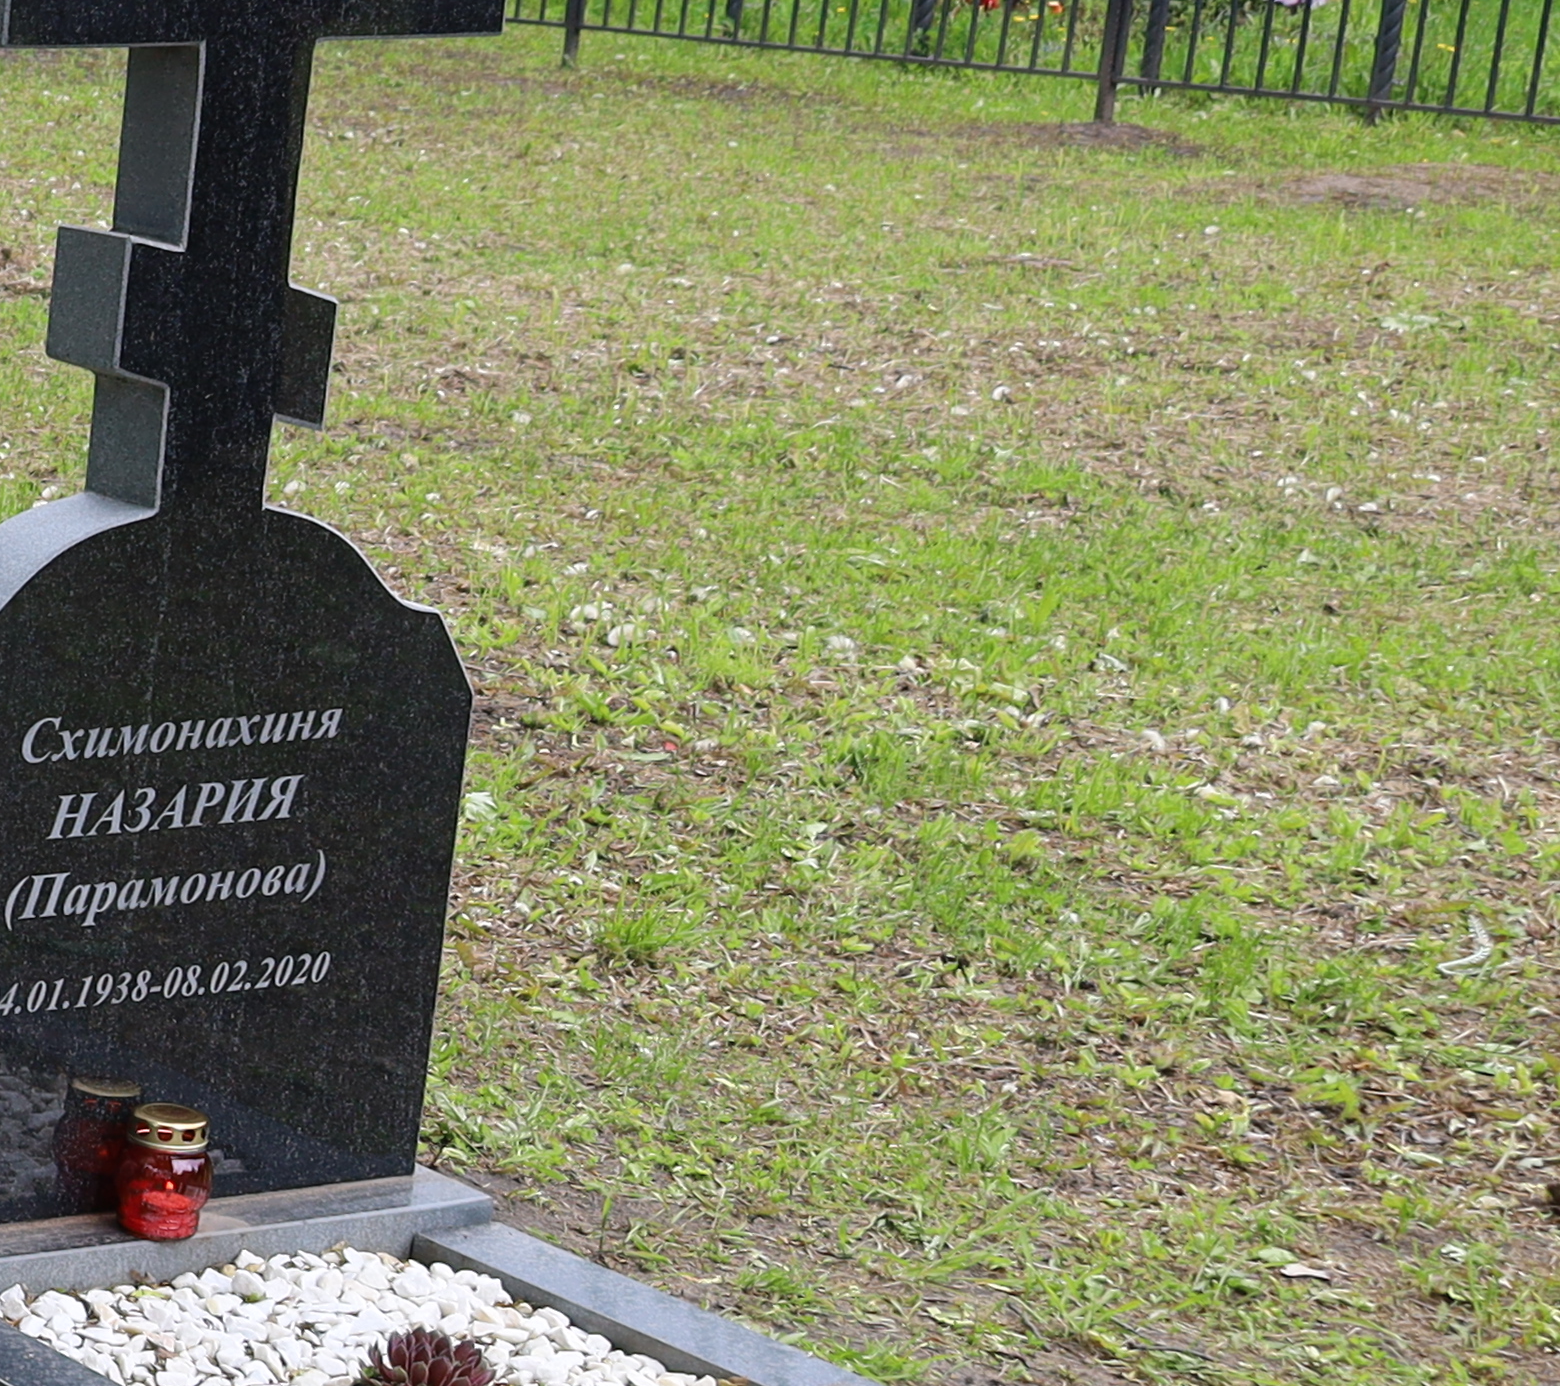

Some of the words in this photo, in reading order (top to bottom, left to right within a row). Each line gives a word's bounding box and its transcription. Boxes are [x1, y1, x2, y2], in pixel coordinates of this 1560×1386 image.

[20, 708, 344, 764] Схимонахиня
[46, 774, 305, 840] НАЗАРИЯ
[4, 849, 327, 931] (Парамонова)
